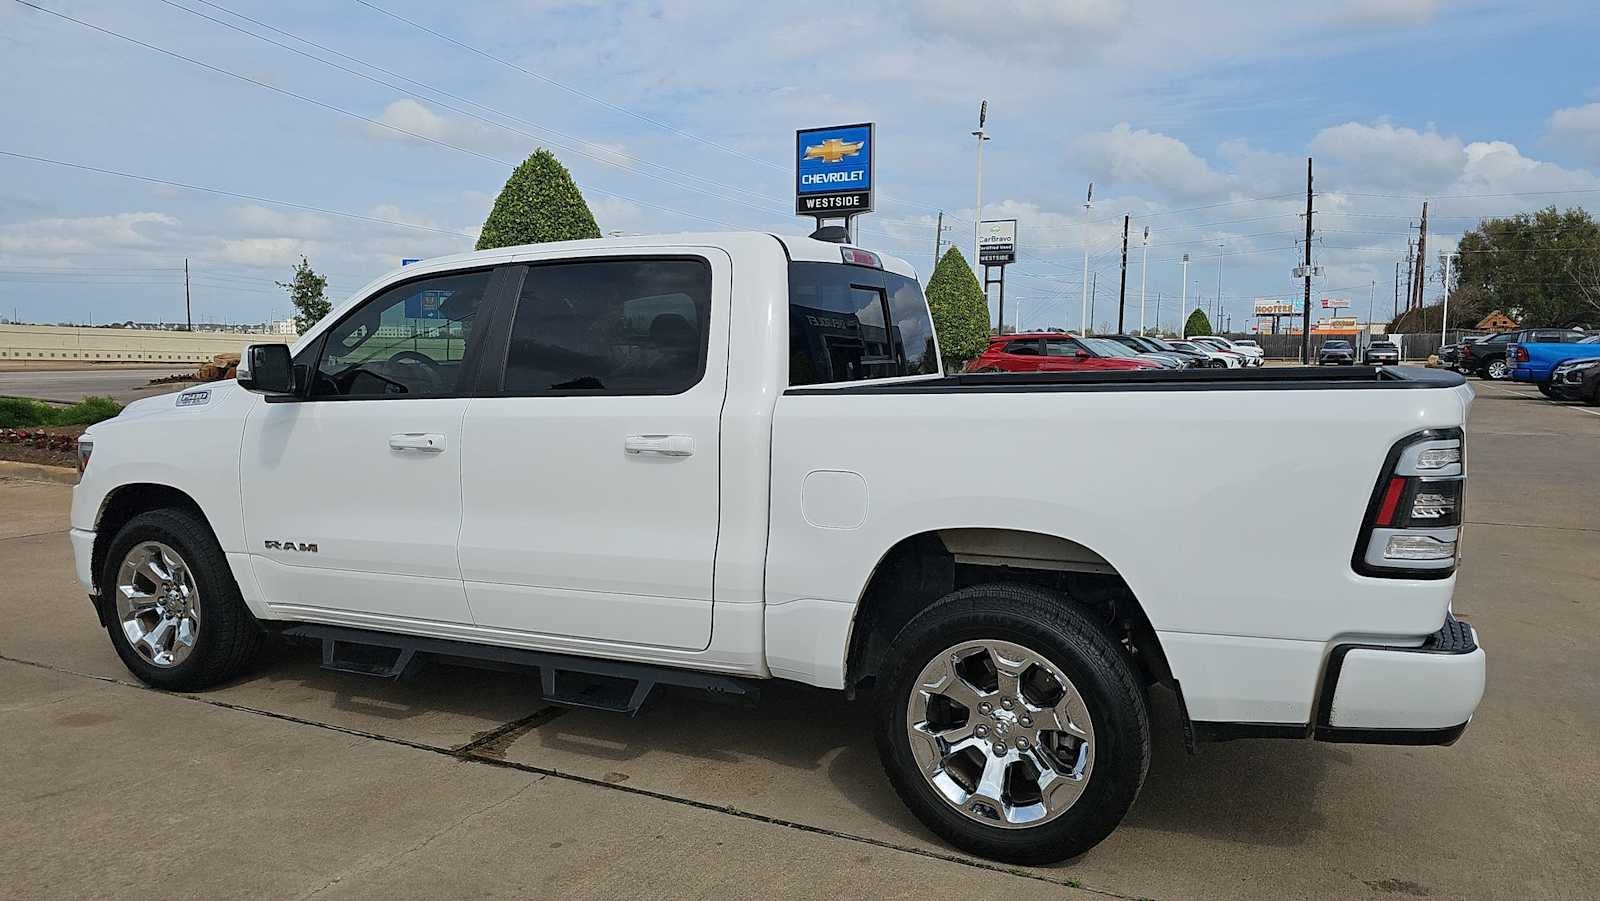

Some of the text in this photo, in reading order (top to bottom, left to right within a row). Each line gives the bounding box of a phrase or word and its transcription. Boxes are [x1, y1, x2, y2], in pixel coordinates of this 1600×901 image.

[802, 171, 864, 184] CHEVROLET
[806, 195, 860, 208] WESTSIDE
[264, 540, 318, 552] RAM
